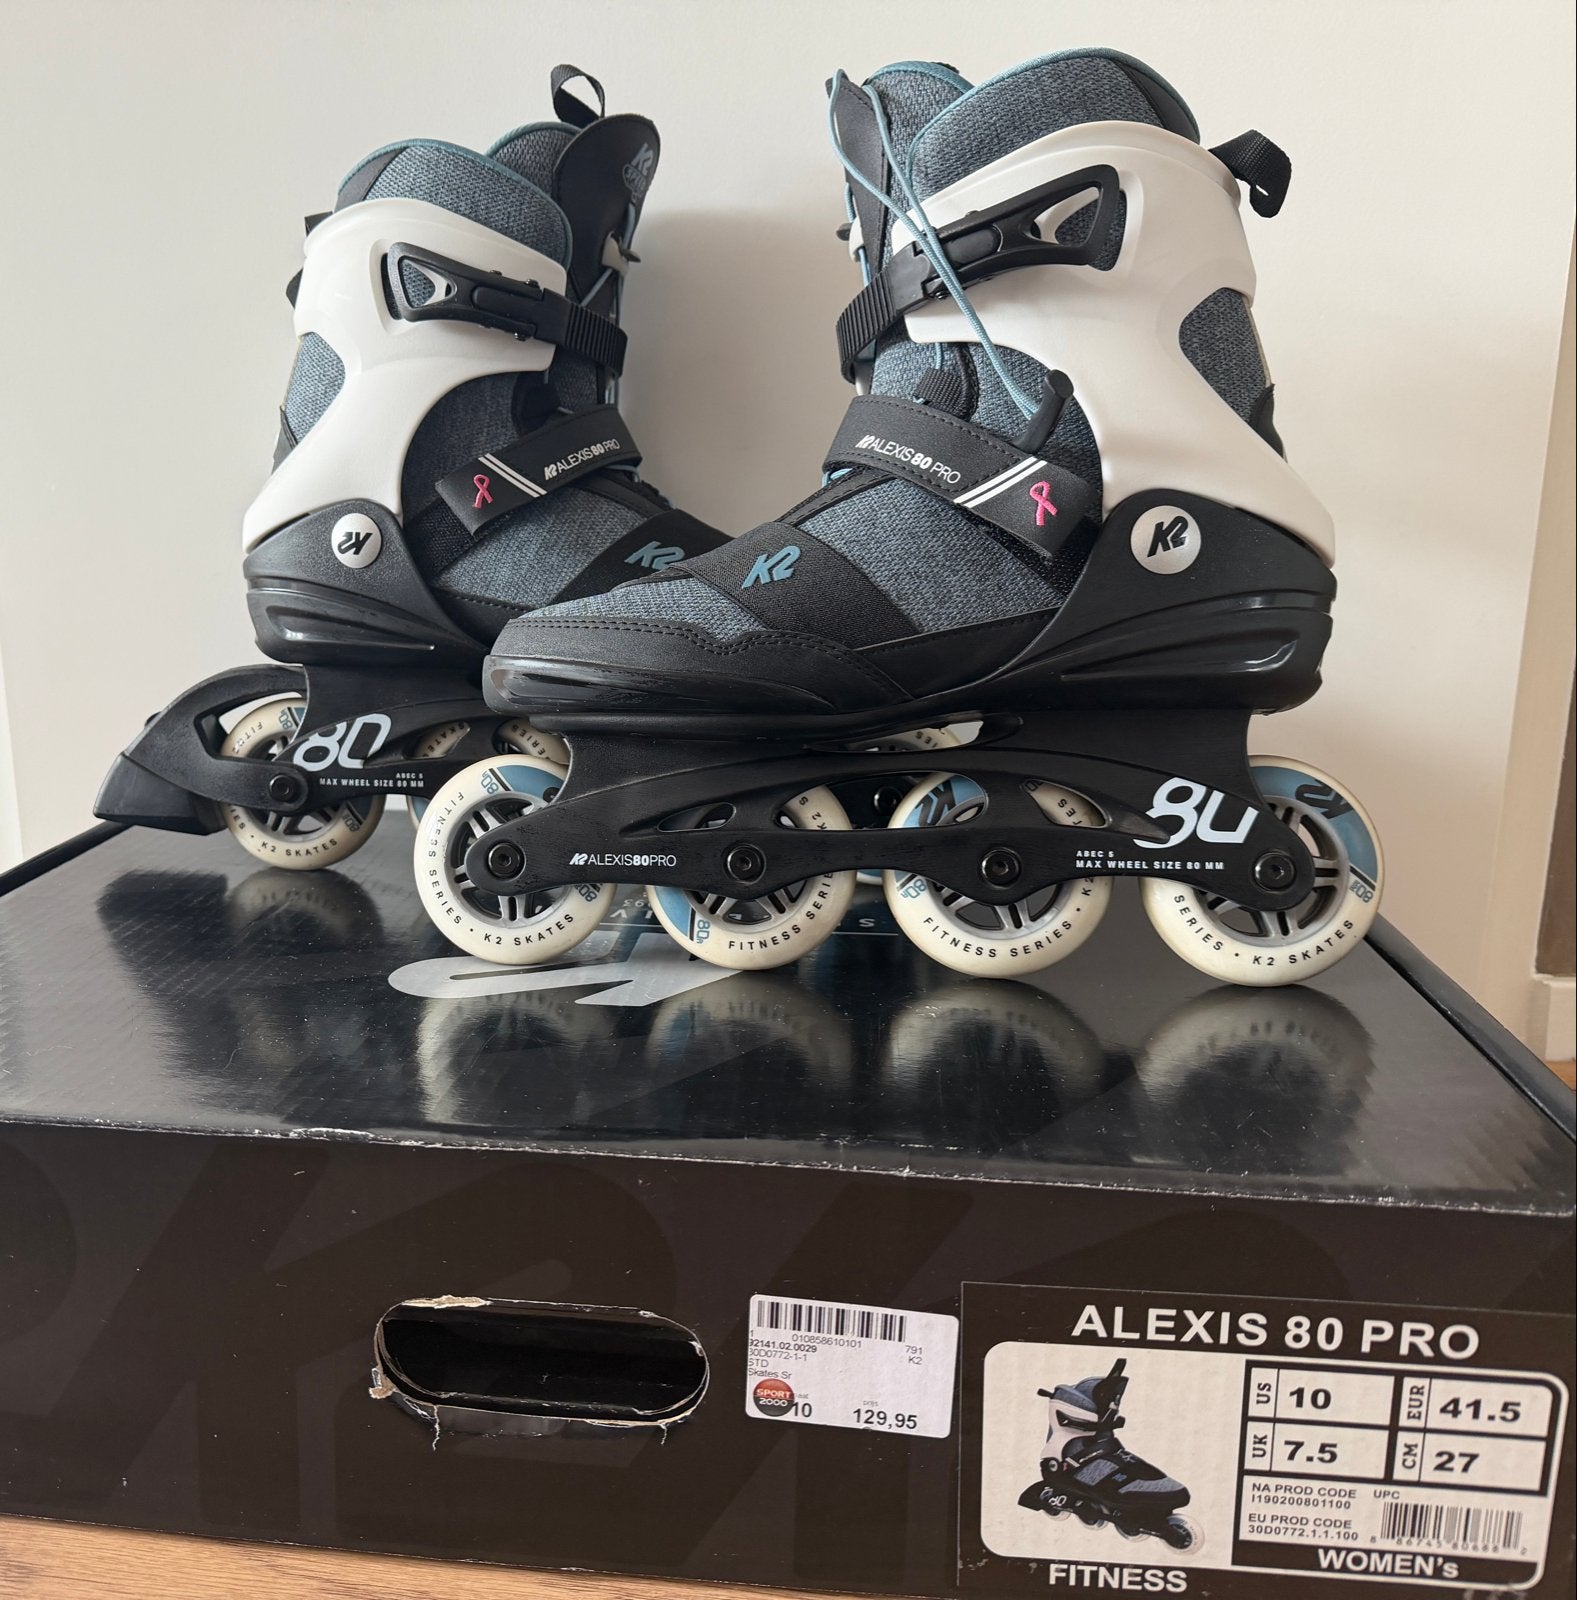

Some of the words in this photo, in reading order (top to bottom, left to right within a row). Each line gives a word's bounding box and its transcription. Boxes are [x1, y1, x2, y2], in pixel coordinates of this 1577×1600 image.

[603, 438, 622, 452] PRO
[929, 461, 961, 485] PRO
[1146, 515, 1189, 558] K2
[624, 540, 686, 571] K2
[741, 545, 802, 589] K2
[292, 712, 392, 772] 80
[319, 778, 338, 786] MAX
[341, 778, 371, 787] WHEEL
[373, 779, 394, 787] SIZE
[396, 780, 407, 788] 80
[410, 780, 424, 788] MM
[1133, 776, 1259, 849] 80
[261, 840, 277, 853] K2
[285, 838, 338, 857] SKATES
[1076, 850, 1105, 858] ABEC
[1108, 850, 1115, 858] 5
[569, 852, 588, 866] K2
[1076, 860, 1103, 869] MAX
[1107, 860, 1149, 869] WHEEL
[1153, 861, 1182, 870] SIZE
[1185, 861, 1200, 870] 80
[1204, 861, 1225, 870] MM
[429, 869, 463, 924] SERIES
[484, 932, 502, 946] K2
[513, 912, 574, 947] SKATES
[728, 924, 802, 951] FITNESS
[805, 872, 834, 921] SERIE
[923, 916, 997, 958] FITNESS
[1010, 919, 1072, 957] SERIES
[1173, 893, 1223, 952] SERIES
[1252, 953, 1275, 966] K2
[1287, 918, 1354, 965] SKATES
[791, 1333, 862, 1349] 010858610101
[1070, 1304, 1268, 1346] ALEXIS
[1283, 1316, 1345, 1353] 80
[1360, 1320, 1480, 1360] PRO
[904, 1345, 924, 1355] 791
[748, 1359, 769, 1369] STD
[907, 1355, 923, 1365] K2
[748, 1368, 780, 1380] Skates
[781, 1371, 792, 1380] Sr
[756, 1388, 792, 1399] SPORT
[758, 1397, 788, 1407] 2000
[1256, 1381, 1272, 1405] US
[1288, 1387, 1332, 1410] 10
[1407, 1384, 1426, 1421] EUR
[1439, 1397, 1522, 1423] 41.5
[792, 1402, 813, 1419] 10
[852, 1408, 918, 1430] 129,95
[1252, 1433, 1268, 1459] UK
[1283, 1440, 1339, 1465] 7.5
[1402, 1442, 1418, 1470] CM
[1433, 1451, 1480, 1474] 27
[1251, 1482, 1272, 1493] NA
[1274, 1483, 1314, 1496] PROD
[1317, 1486, 1358, 1499] CODE
[1373, 1488, 1401, 1500] UPC
[1248, 1512, 1266, 1524] EU
[1270, 1514, 1310, 1527] PROD
[1313, 1517, 1353, 1530] CODE
[1248, 1524, 1359, 1541] 30D0772.1.1.100
[1317, 1549, 1460, 1579] WOMEN's
[1048, 1564, 1188, 1594] FITNESS
